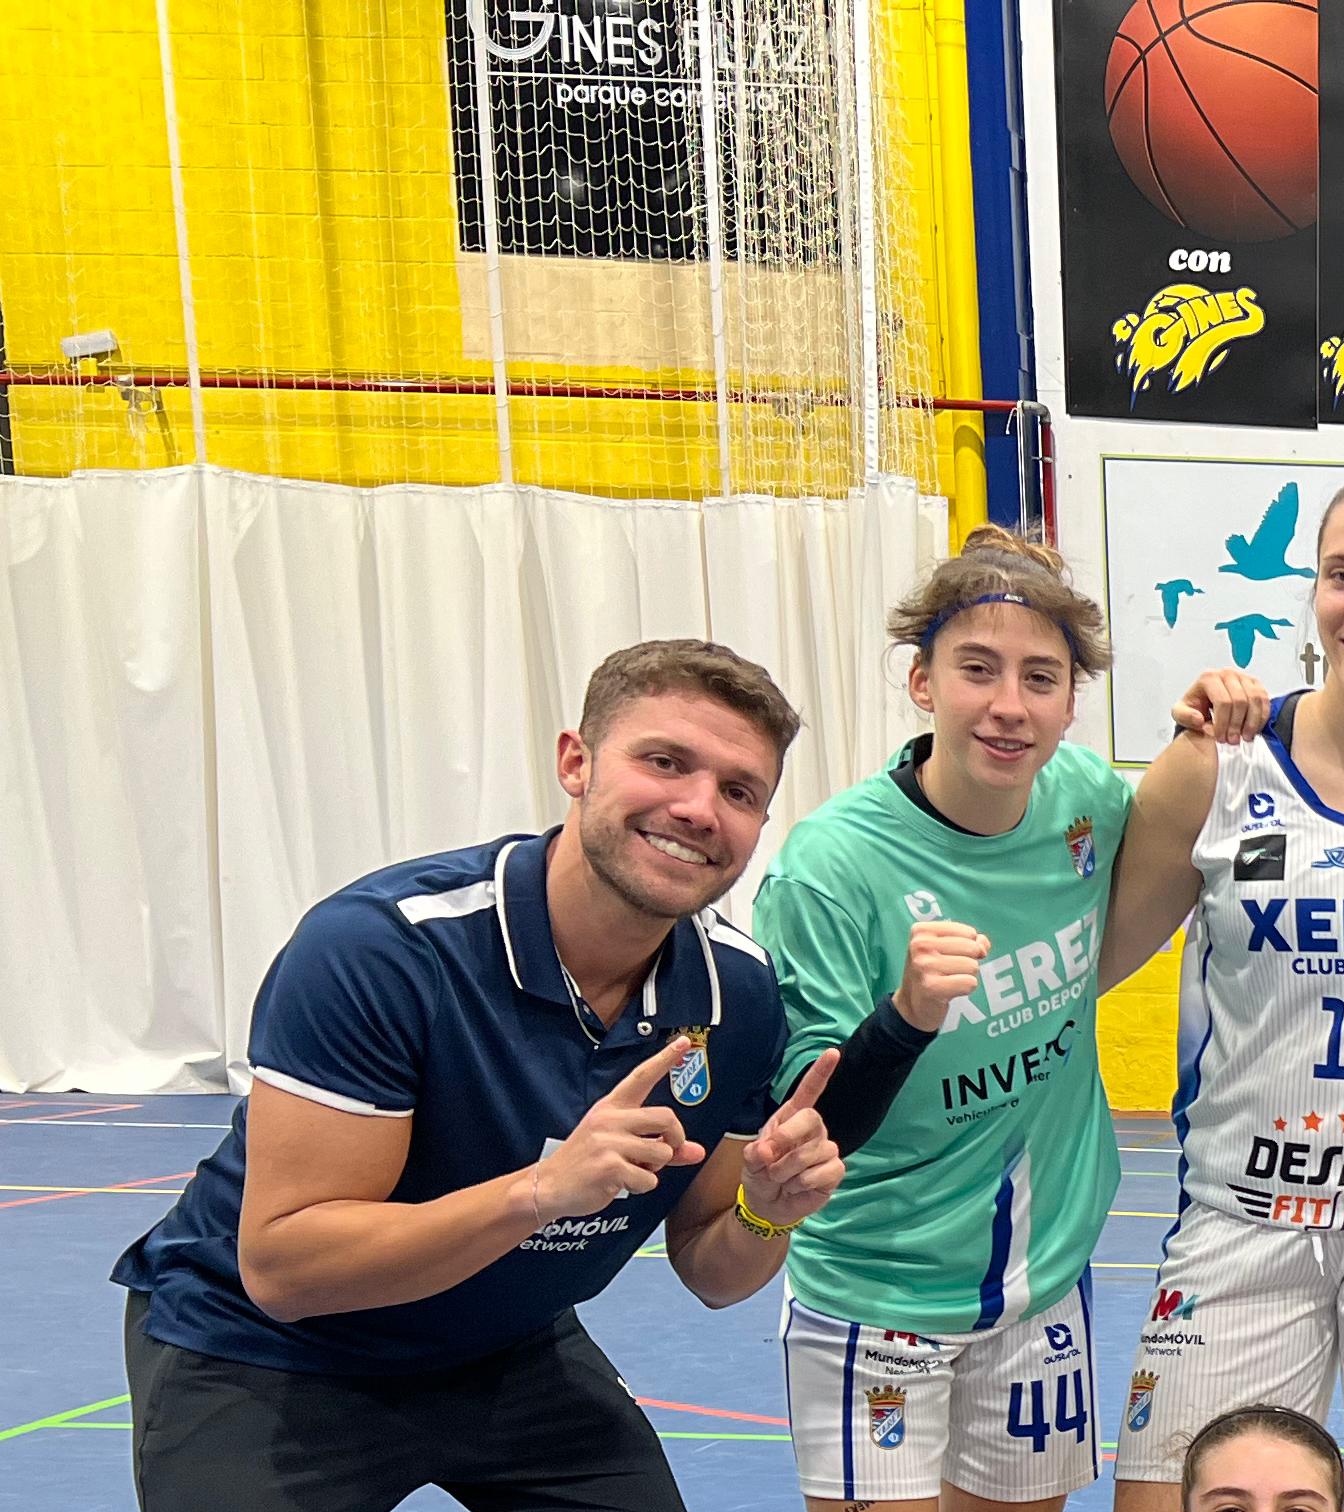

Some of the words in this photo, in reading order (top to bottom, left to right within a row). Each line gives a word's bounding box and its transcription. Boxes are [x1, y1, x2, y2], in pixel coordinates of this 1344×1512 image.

[556, 83, 643, 108] parque
[1168, 248, 1233, 273] con
[1128, 286, 1266, 394] GINES
[986, 1002, 1035, 1038] CLUB
[1271, 1194, 1331, 1224] FIT
[519, 1236, 590, 1251] etwork
[1007, 1369, 1088, 1454] 44
